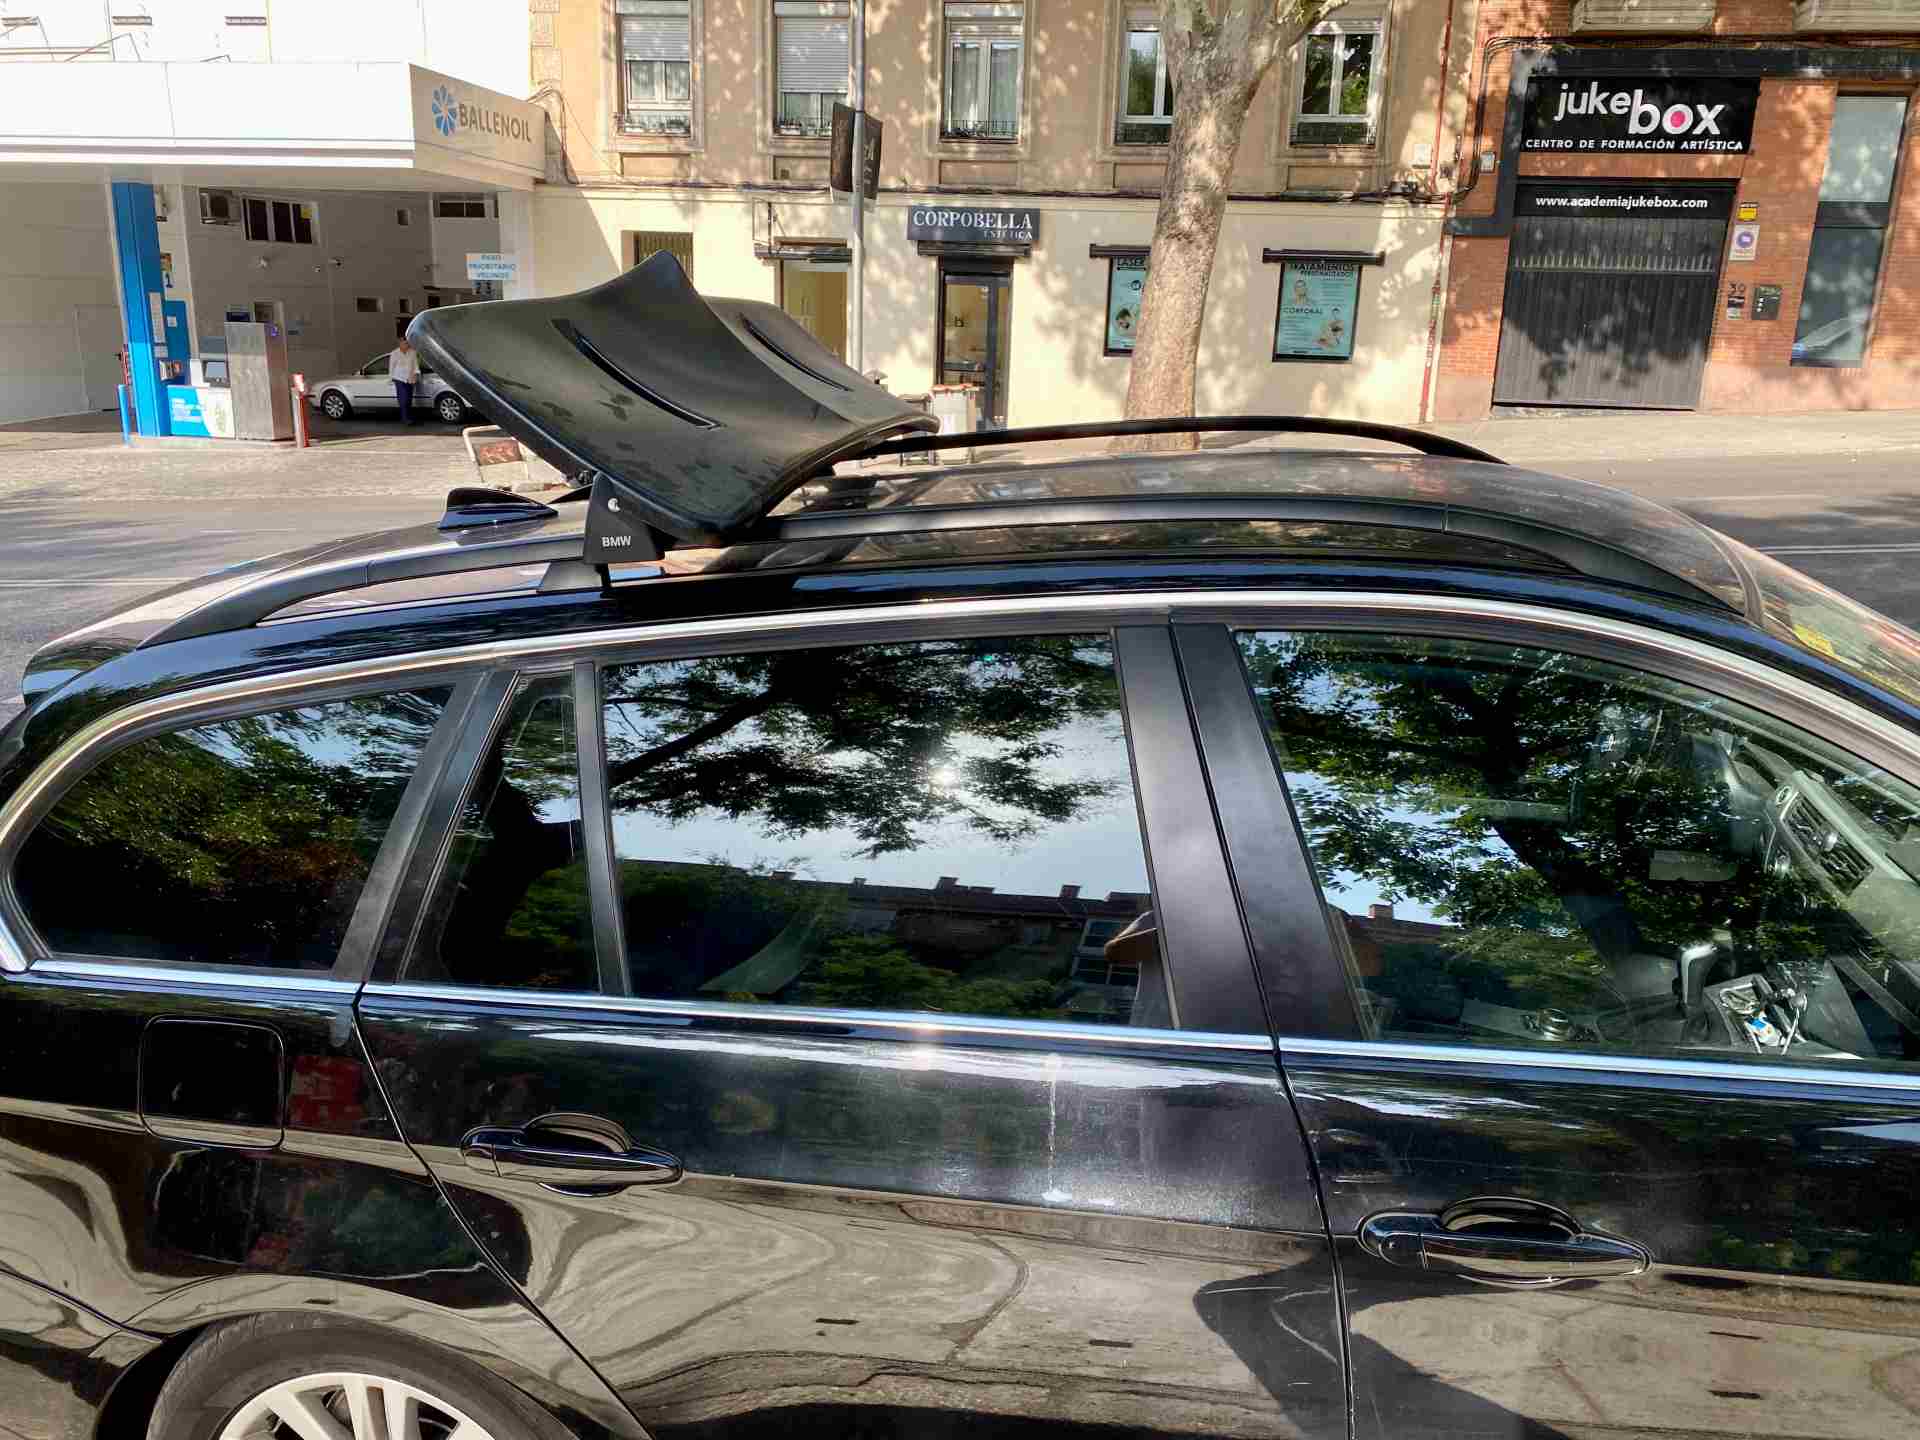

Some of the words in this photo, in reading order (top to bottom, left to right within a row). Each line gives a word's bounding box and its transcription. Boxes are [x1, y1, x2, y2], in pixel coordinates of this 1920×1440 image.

[1553, 82, 1725, 134] jukebox
[459, 104, 531, 142] BALLENOIL
[1525, 138, 1574, 150] CENTRO
[1579, 139, 1596, 150] DE
[1600, 138, 1676, 151] FORMACIÓN
[1680, 138, 1744, 151] ARTÍSTICA
[1535, 195, 1709, 211] www.academiajukebox.com
[913, 210, 1033, 230] CORPOBELLA
[601, 535, 631, 548] BMW
